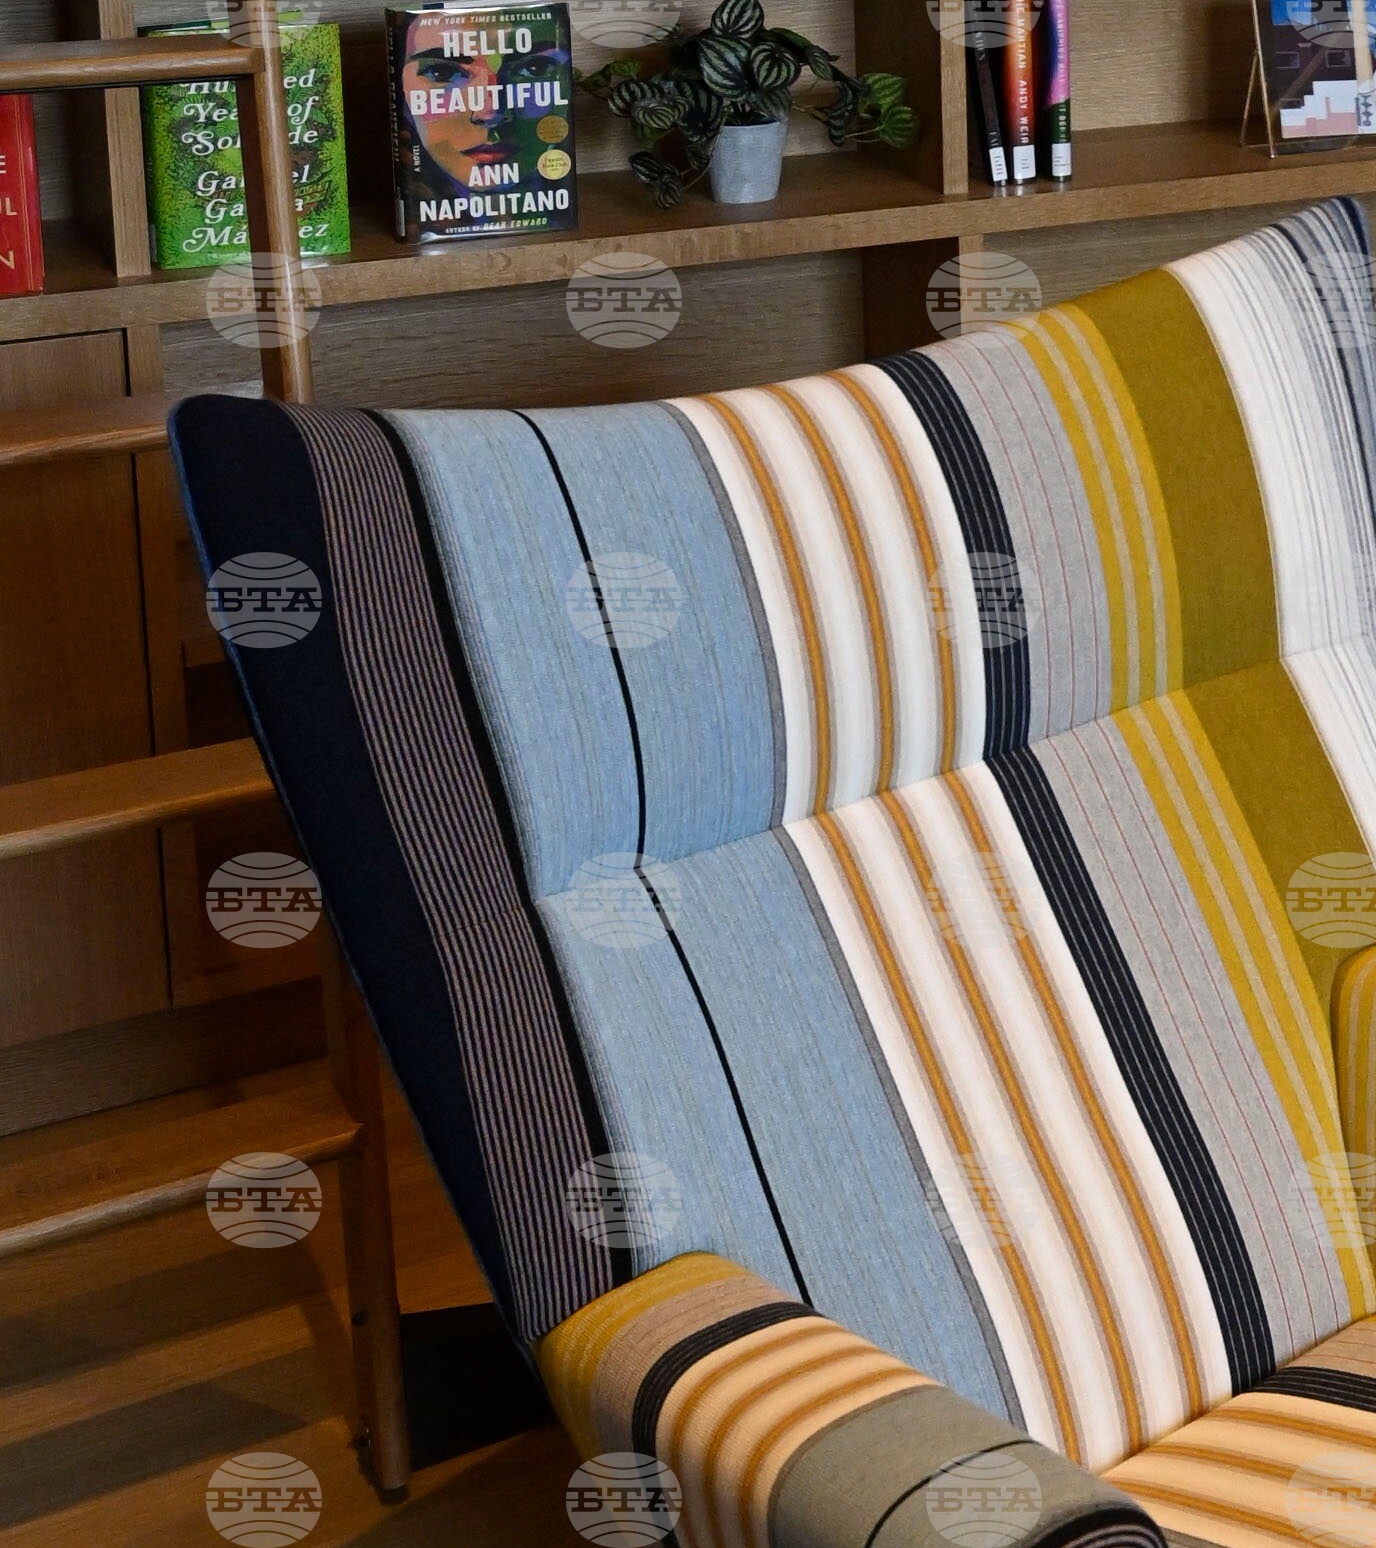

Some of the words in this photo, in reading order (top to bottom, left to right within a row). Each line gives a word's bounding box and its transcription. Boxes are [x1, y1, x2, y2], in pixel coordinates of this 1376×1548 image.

[420, 17, 442, 26] NEW
[445, 16, 466, 25] YORK
[469, 15, 497, 24] TIMES
[499, 12, 552, 22] BESTSELLER
[443, 27, 532, 58] HELLO
[1016, 18, 1026, 69] MARTIAN
[410, 81, 569, 116] BEAUTIFUL
[1018, 80, 1028, 110] ANDY
[287, 96, 319, 126] of
[1018, 116, 1029, 144] WEIR
[468, 162, 520, 187] ANN
[419, 188, 570, 222] NAPOLITANO
[482, 220, 507, 231] DEAR
[510, 217, 548, 228] EDWARD
